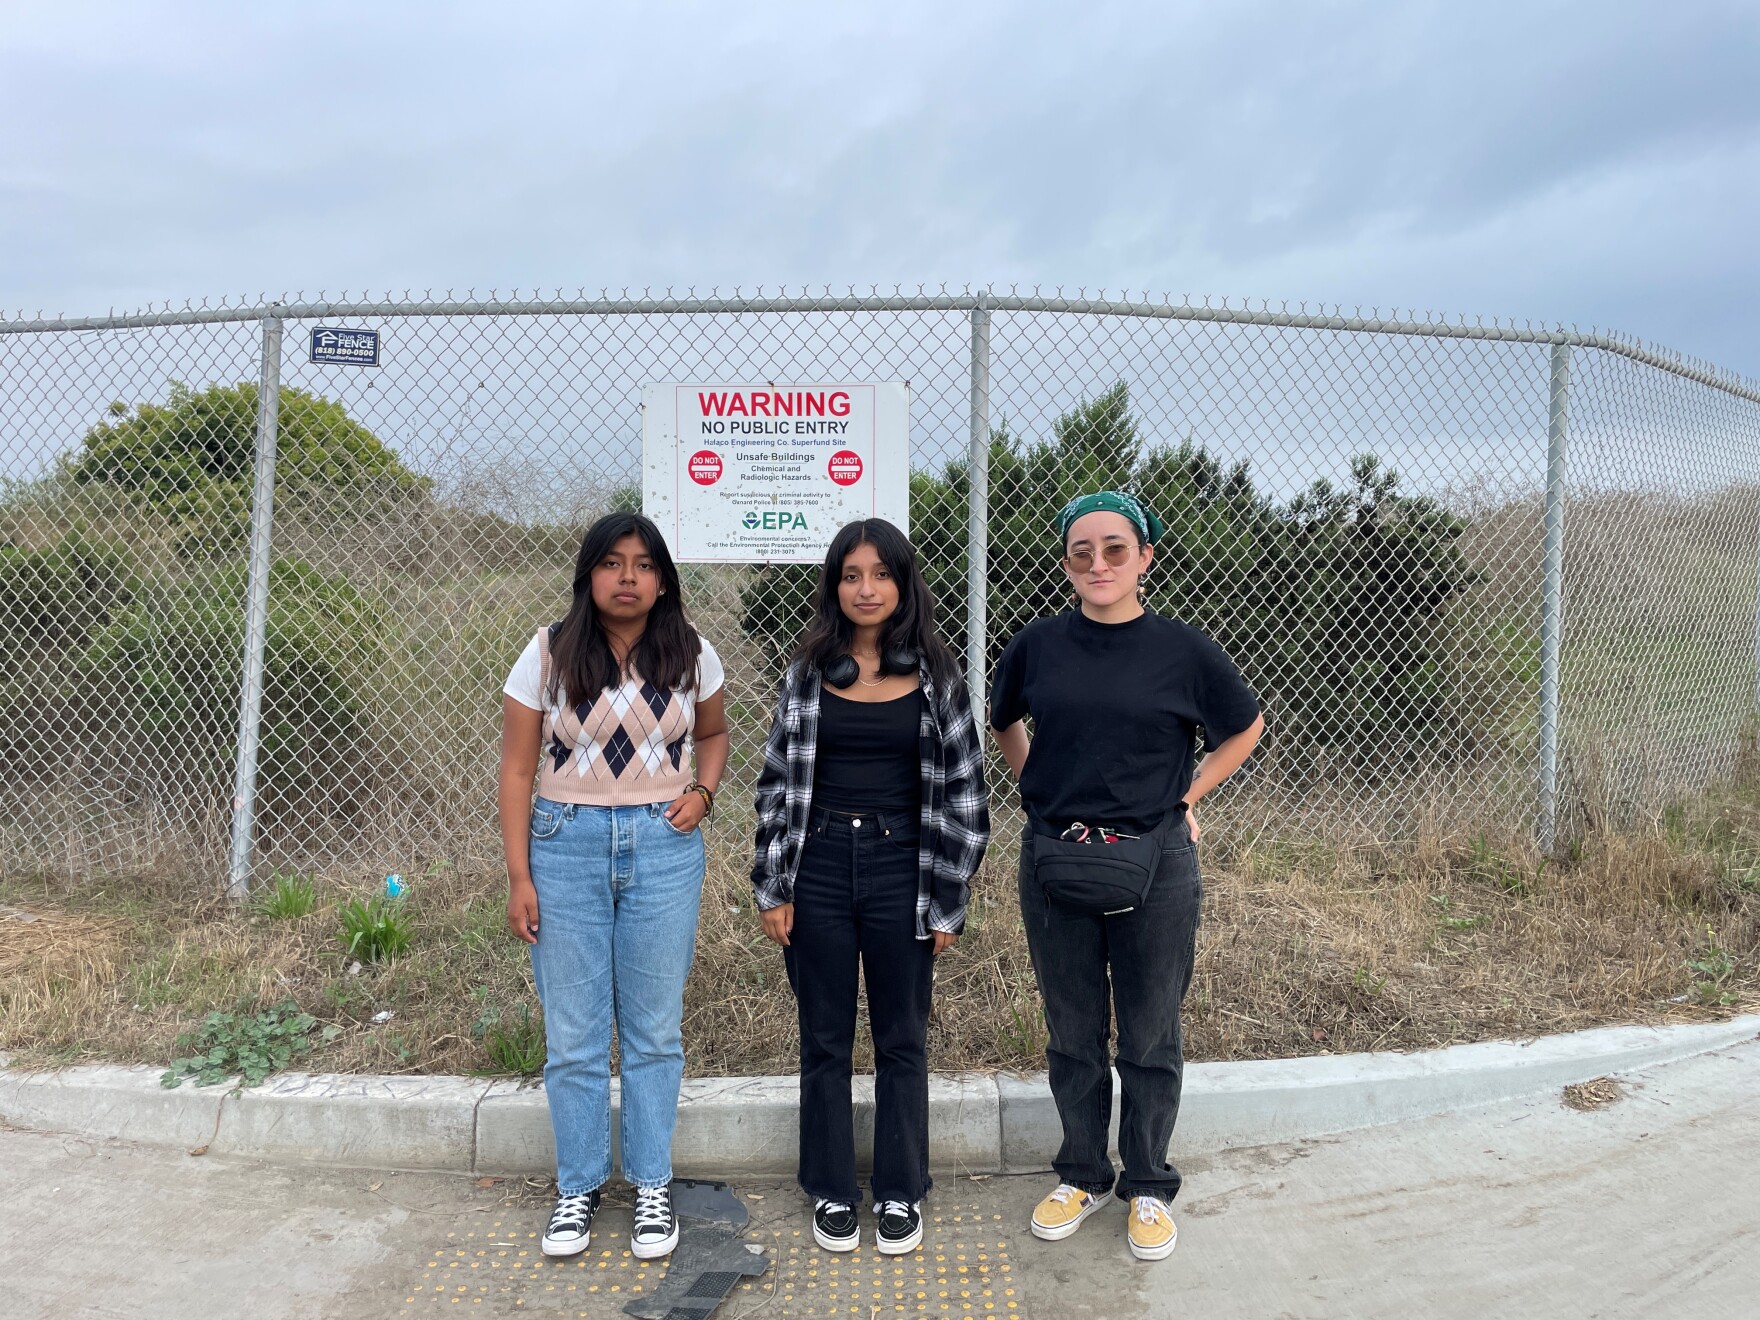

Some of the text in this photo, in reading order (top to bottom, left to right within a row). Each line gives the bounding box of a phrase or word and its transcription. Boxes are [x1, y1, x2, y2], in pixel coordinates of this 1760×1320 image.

[339, 333, 355, 341] Five
[338, 339, 374, 349] FENCE
[315, 347, 374, 356] (818) 890-0500
[698, 391, 851, 417] WARNING
[701, 421, 849, 434] NO PUBLIC ENTRY
[704, 438, 847, 447] Halaco Engineering Co. Superfund Site
[692, 456, 719, 465] DO NOT
[736, 452, 815, 463] Unsafe Buildings
[832, 457, 858, 465] DO NOT
[694, 471, 717, 479] ENTER
[740, 474, 780, 482] Radiologic
[719, 491, 740, 499] Report
[803, 491, 823, 499] activity
[762, 511, 809, 530] EPA
